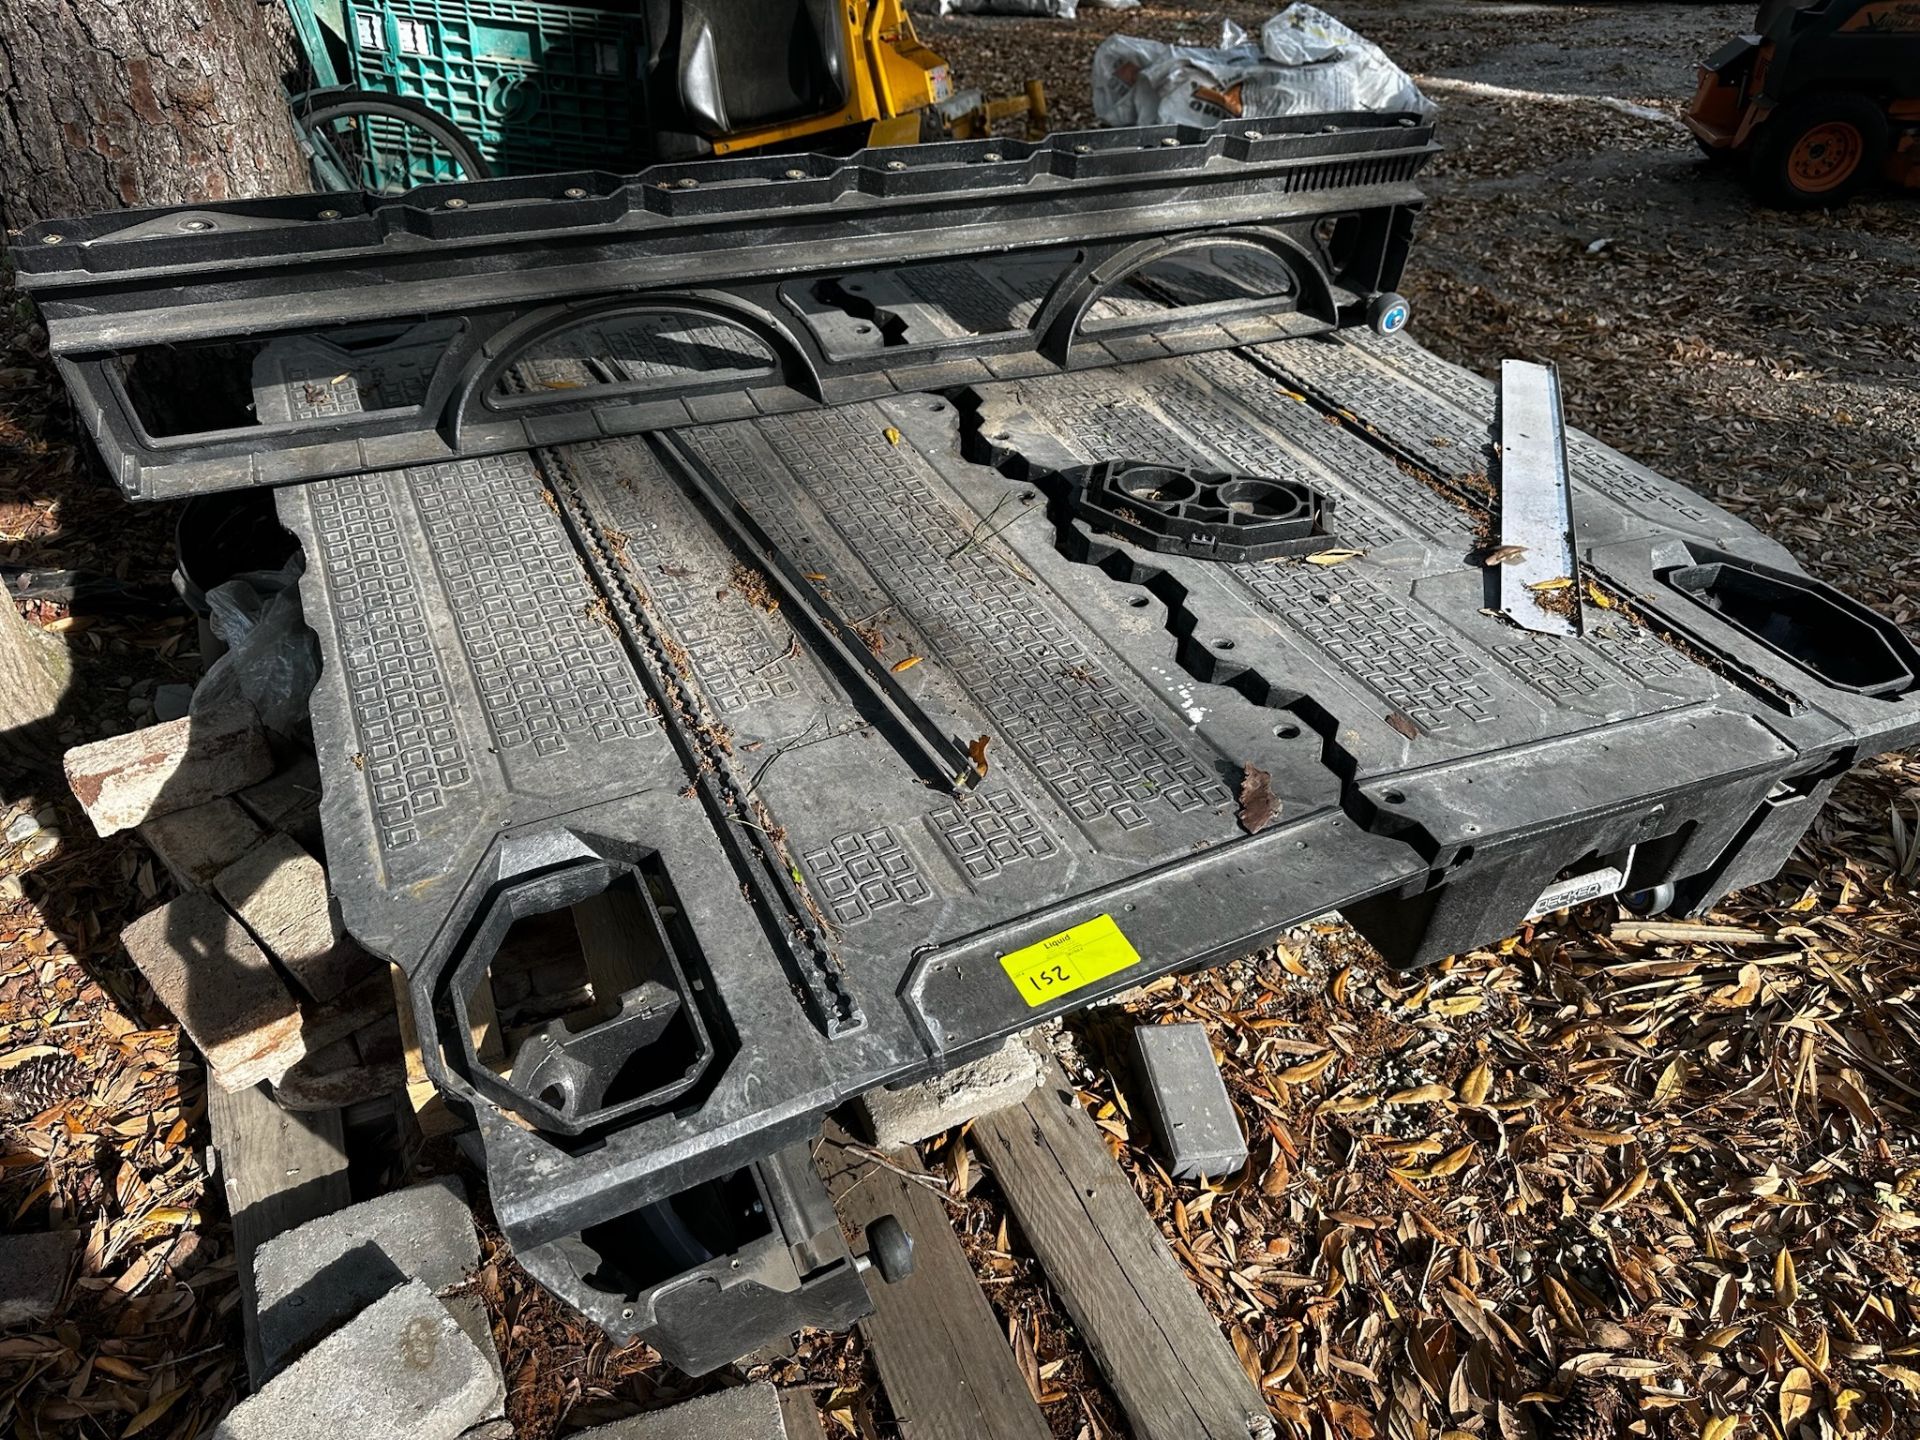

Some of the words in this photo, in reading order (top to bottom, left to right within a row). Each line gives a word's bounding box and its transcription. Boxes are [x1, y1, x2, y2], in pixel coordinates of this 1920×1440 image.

[1536, 883, 1601, 913] DECKED
[1043, 934, 1071, 950] Liquid
[1029, 965, 1071, 990] 251
